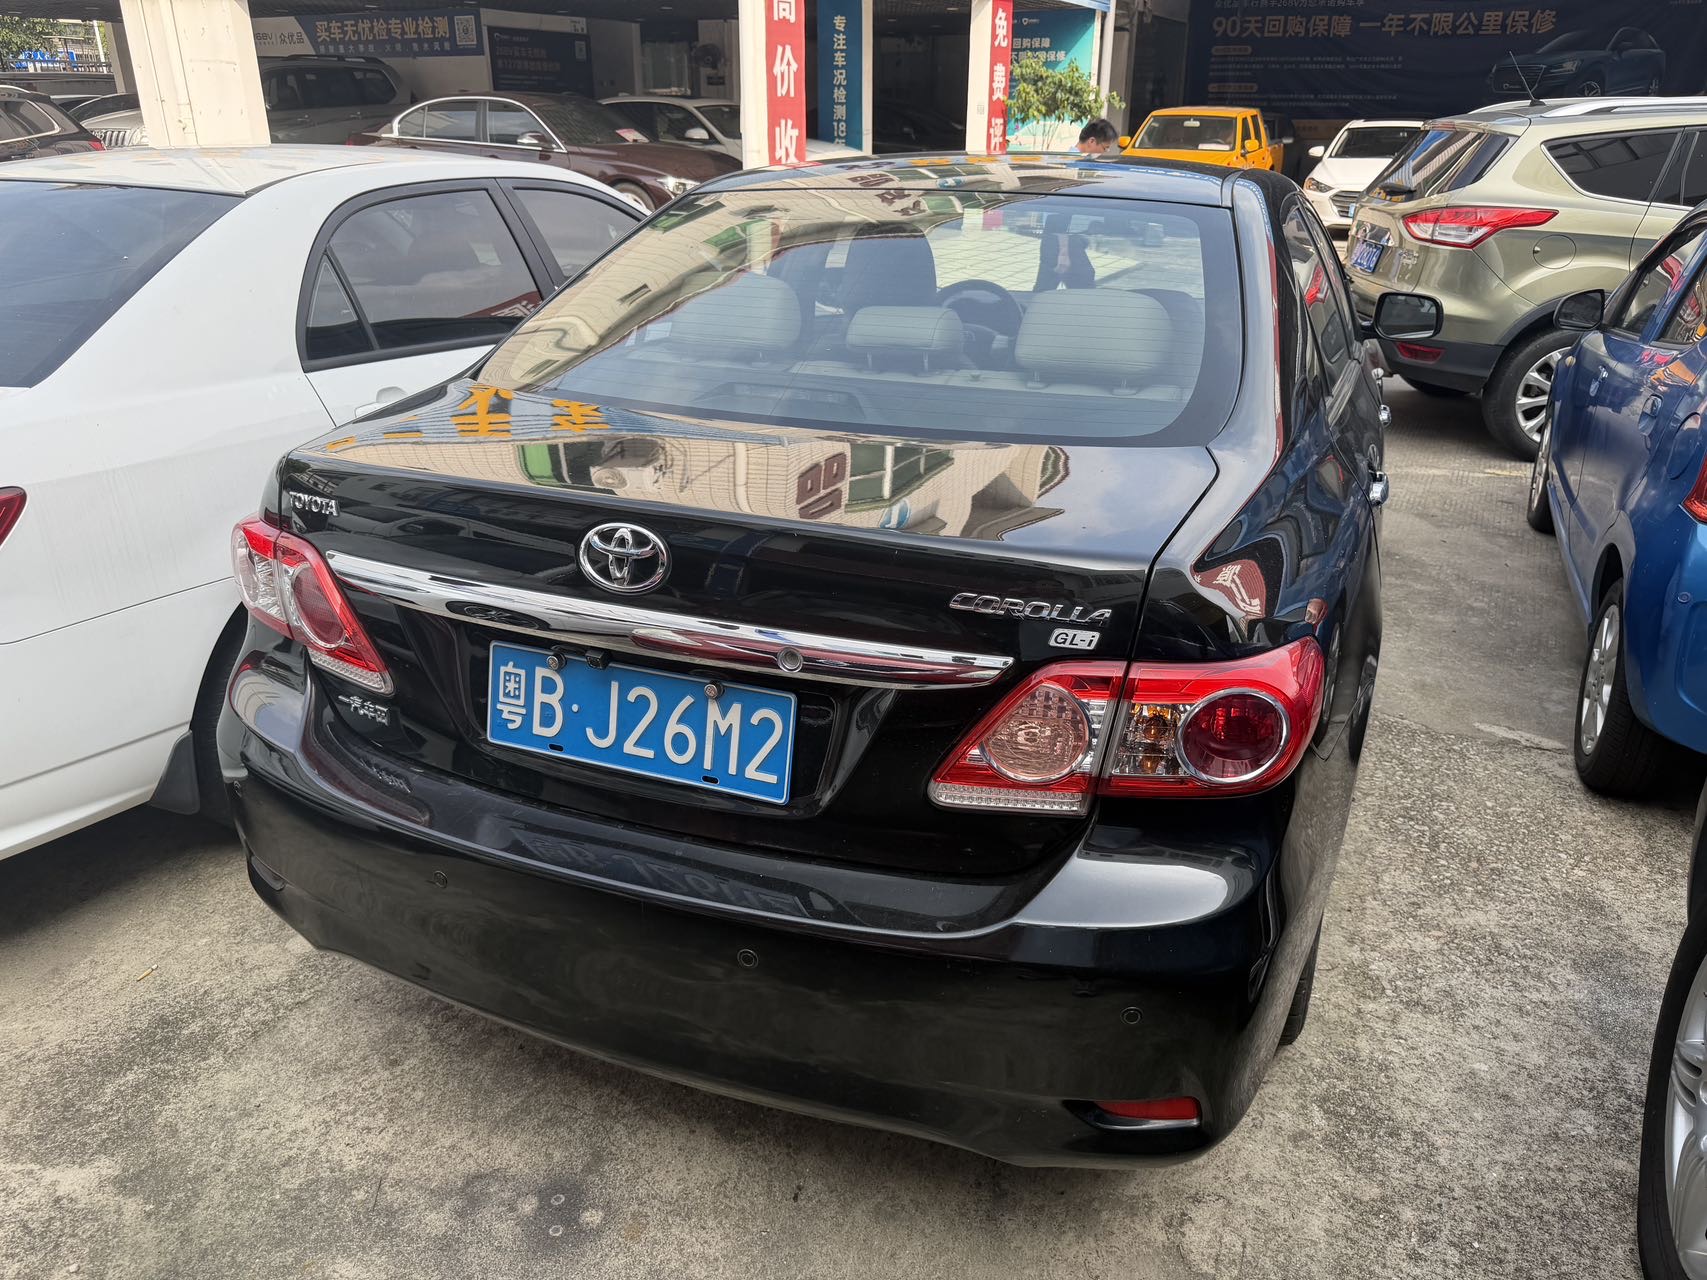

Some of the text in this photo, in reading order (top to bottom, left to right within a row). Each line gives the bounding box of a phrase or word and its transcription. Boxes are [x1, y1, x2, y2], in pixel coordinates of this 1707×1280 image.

[315, 15, 450, 43] 买车无忧检专业检测
[1213, 9, 1557, 38] 90天回购保障 一年不限公里保修
[279, 31, 305, 45] 众优品
[1012, 37, 1051, 49] 回购保障
[289, 491, 339, 517] TOYOTA
[949, 592, 1113, 627] COROLLA
[1054, 632, 1096, 648] GL-i
